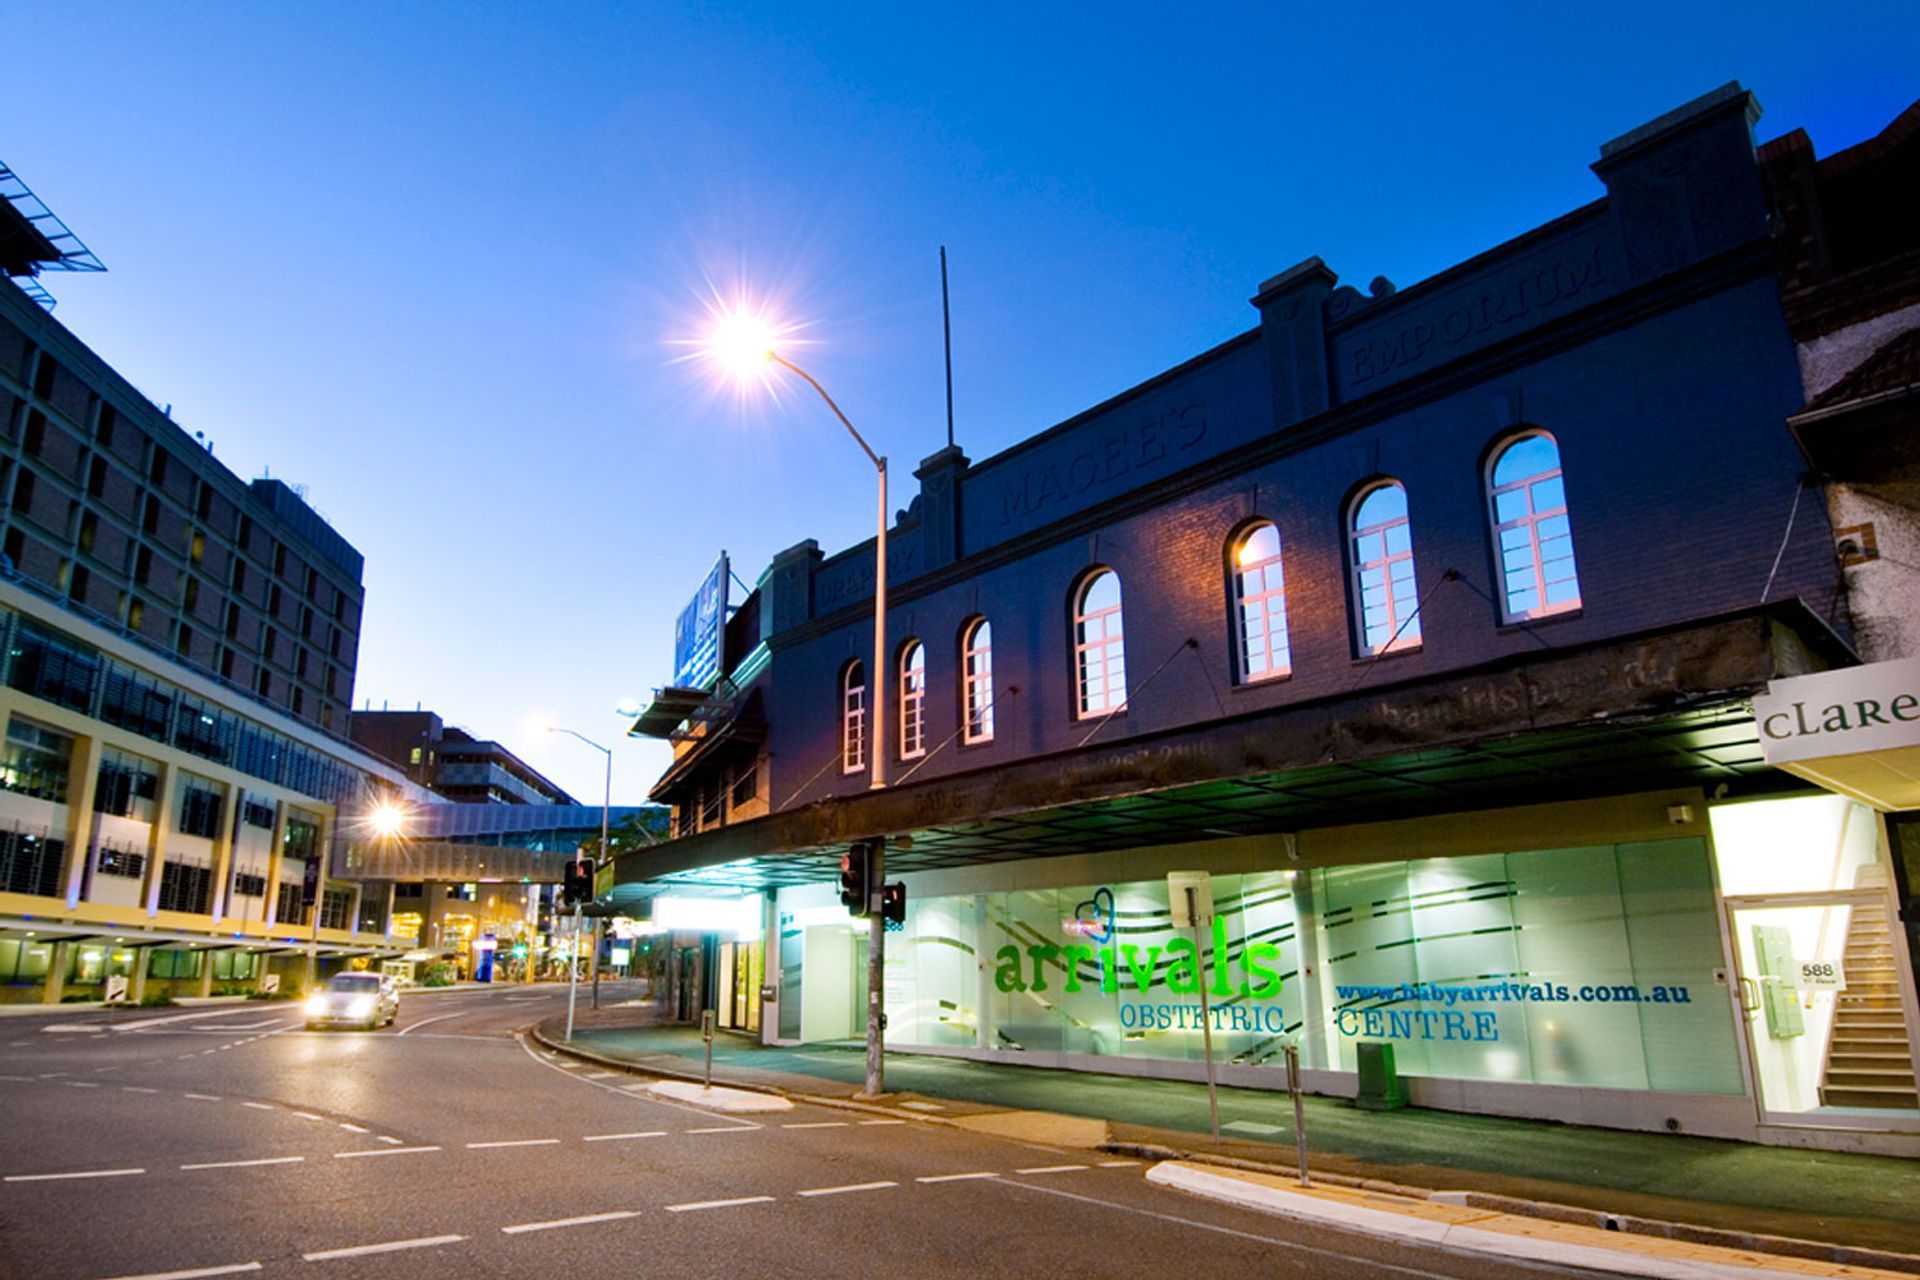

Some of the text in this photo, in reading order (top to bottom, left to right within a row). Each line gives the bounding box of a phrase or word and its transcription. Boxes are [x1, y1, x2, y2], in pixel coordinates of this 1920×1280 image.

[1351, 244, 1609, 386] EMPORIUM
[818, 544, 919, 606] DRAPRY
[995, 915, 1283, 999] arrivals
[1802, 963, 1835, 977] 588
[1336, 982, 1691, 1007] www.babyarrivals.com.au
[1120, 1004, 1499, 1042] OBSTETRIC CENTRE
